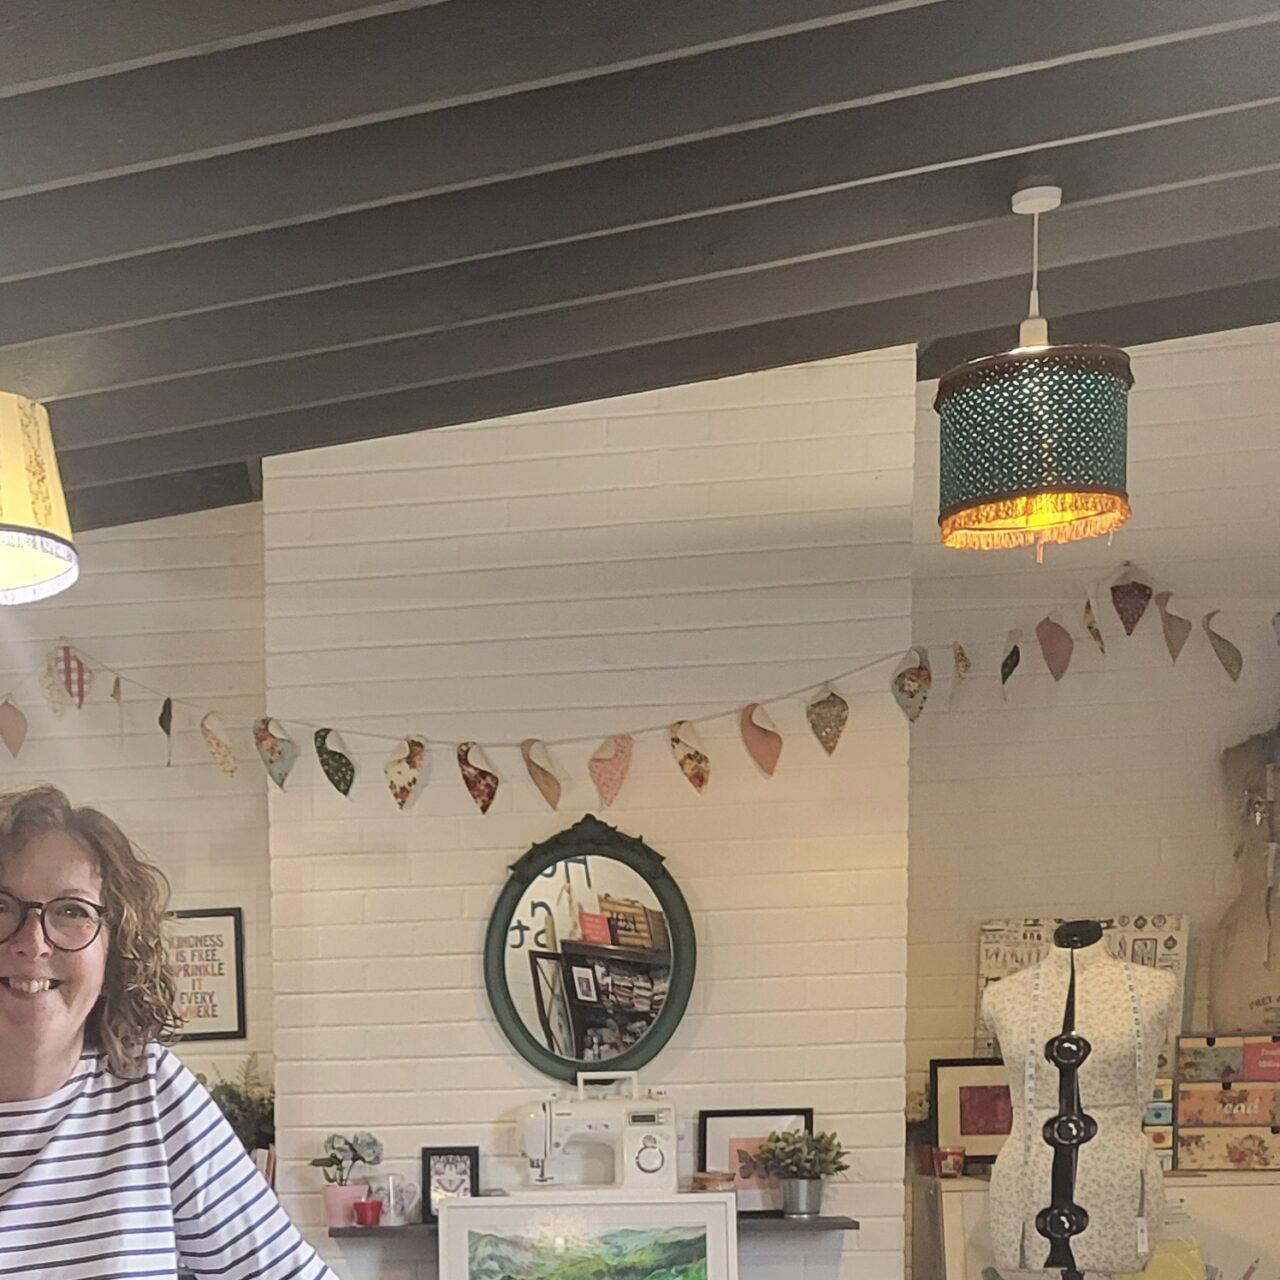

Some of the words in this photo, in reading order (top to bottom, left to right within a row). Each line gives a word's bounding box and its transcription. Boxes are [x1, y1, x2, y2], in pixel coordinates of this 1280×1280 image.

[175, 950, 186, 962] IS
[192, 978, 204, 991] IT
[180, 991, 215, 1004] EVERY
[180, 1004, 219, 1018] WHERE
